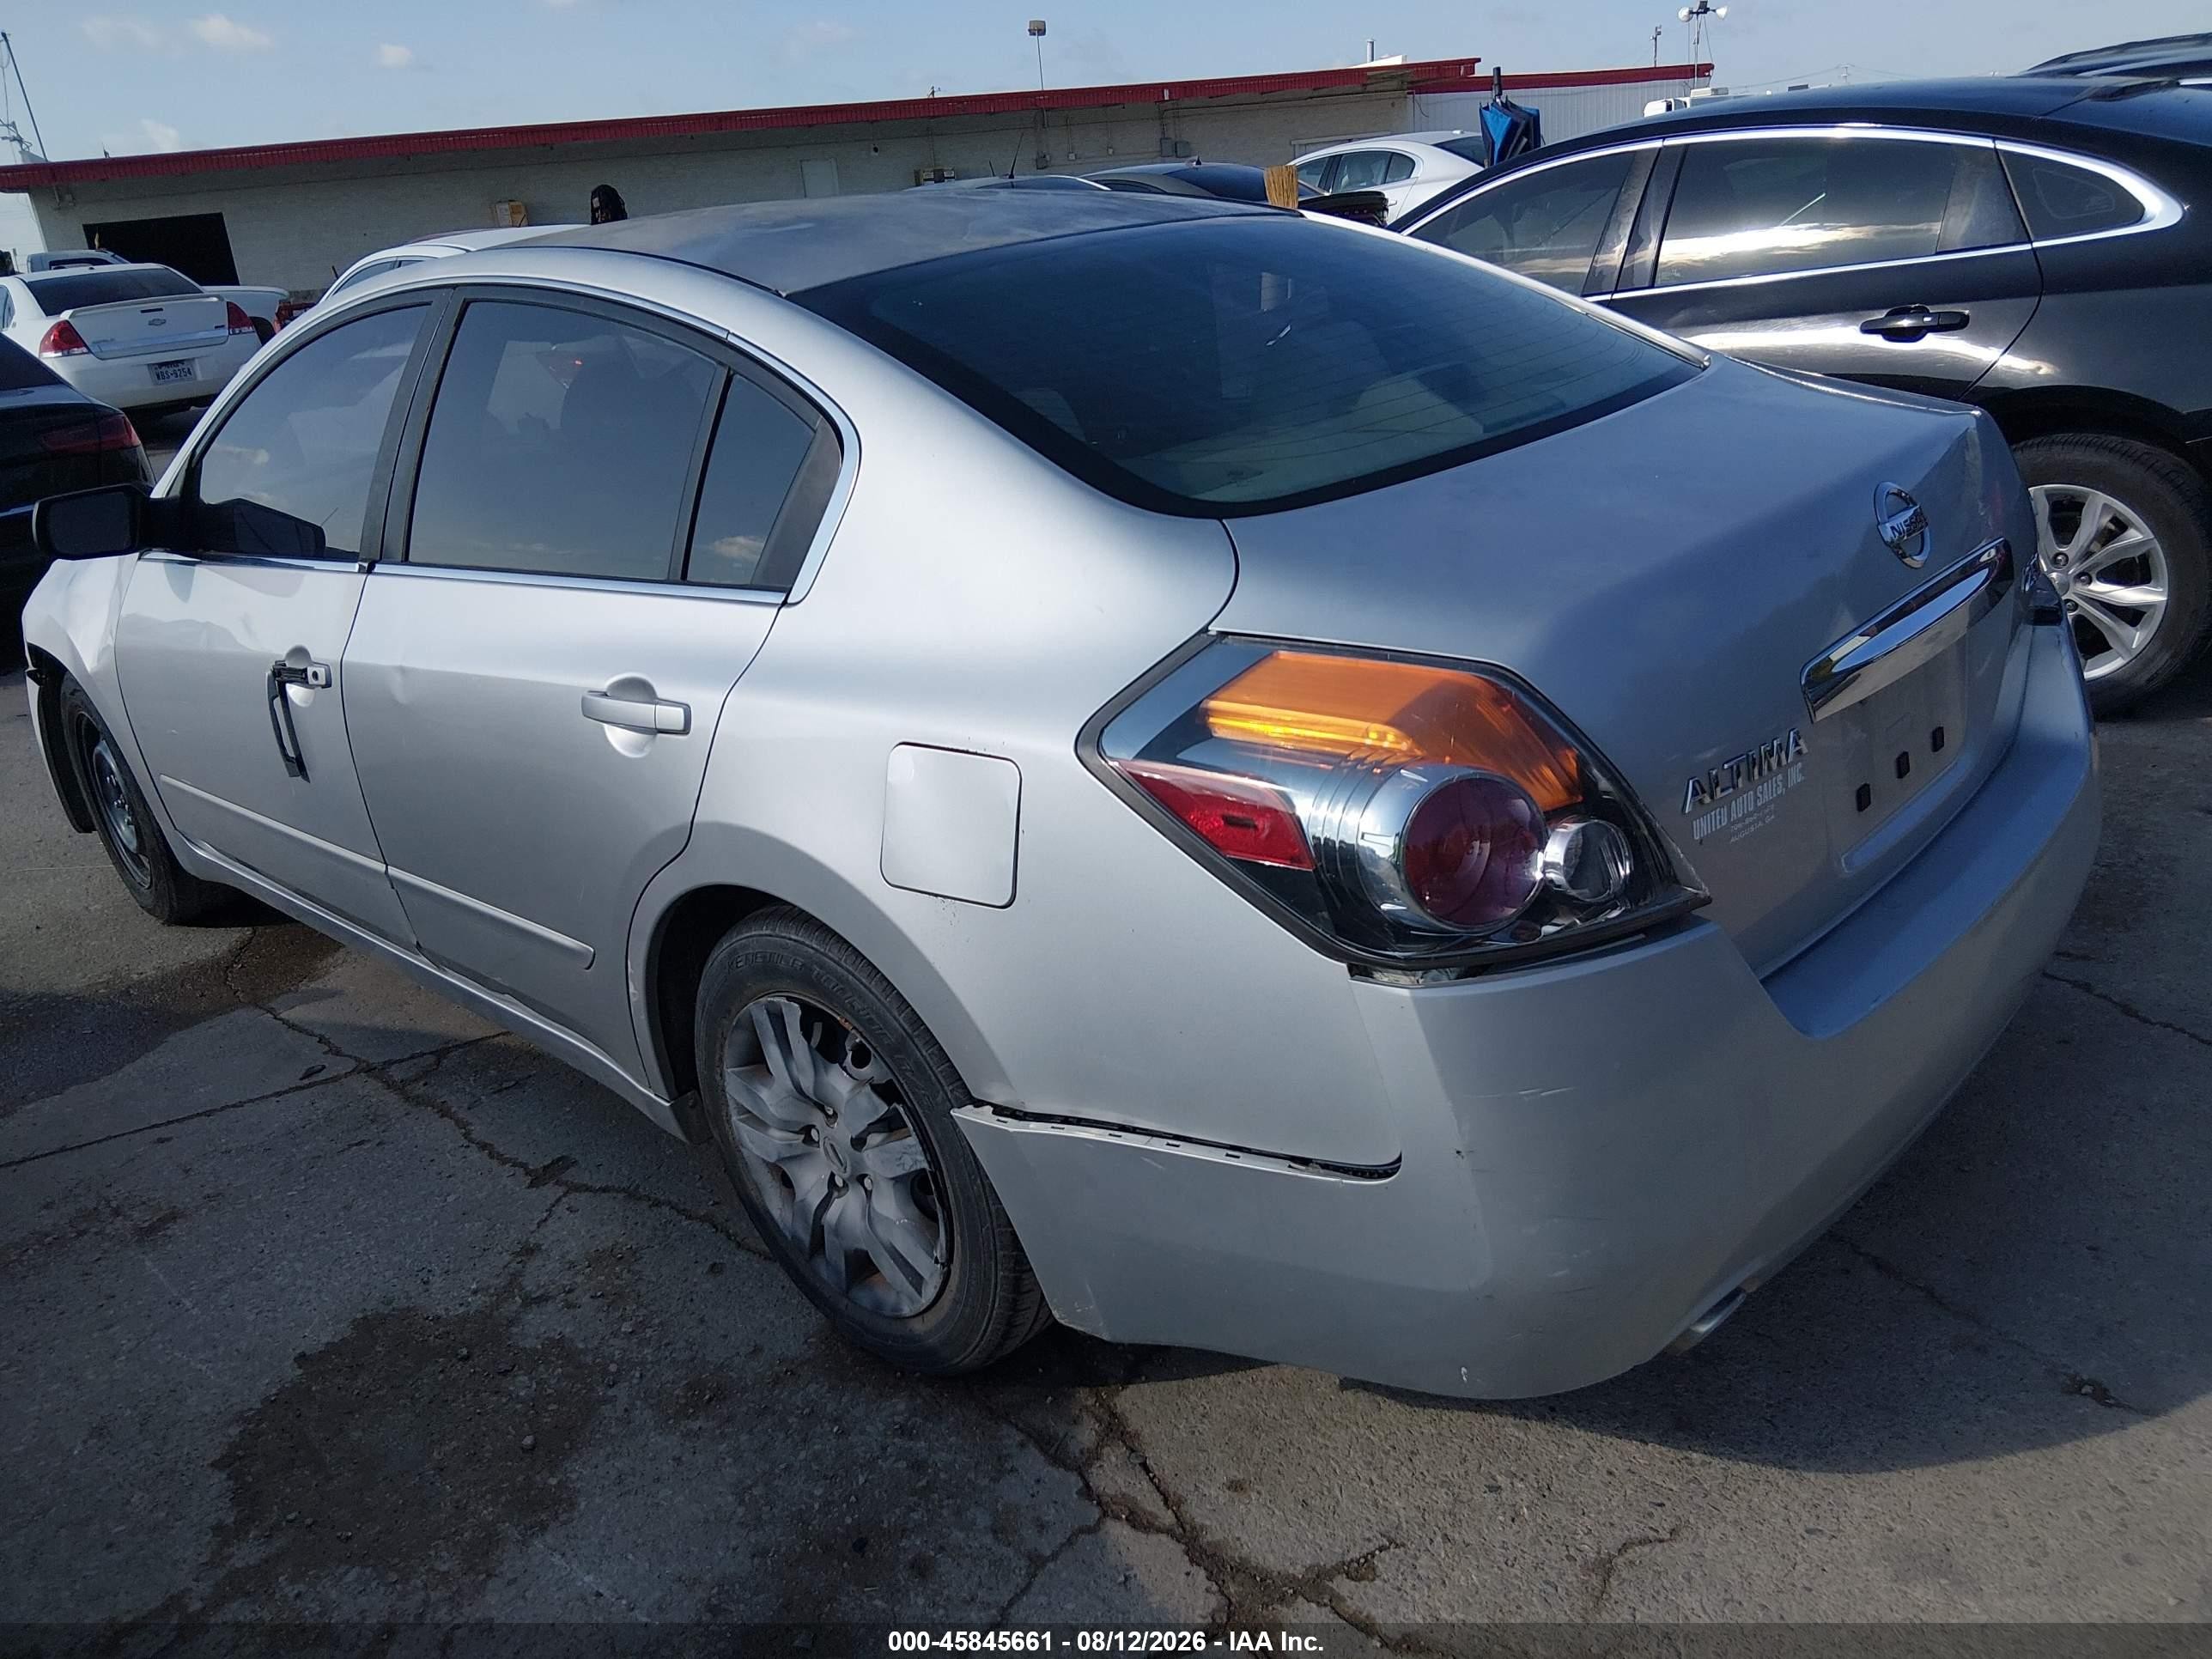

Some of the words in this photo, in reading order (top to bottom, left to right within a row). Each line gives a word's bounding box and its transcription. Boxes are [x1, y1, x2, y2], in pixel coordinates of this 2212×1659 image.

[1682, 727, 1808, 814] ALTIMA
[1692, 805, 1728, 841] UNITED
[1730, 790, 1754, 822] AUTO
[1756, 773, 1786, 806] SALES,
[1787, 762, 1805, 788] INC.
